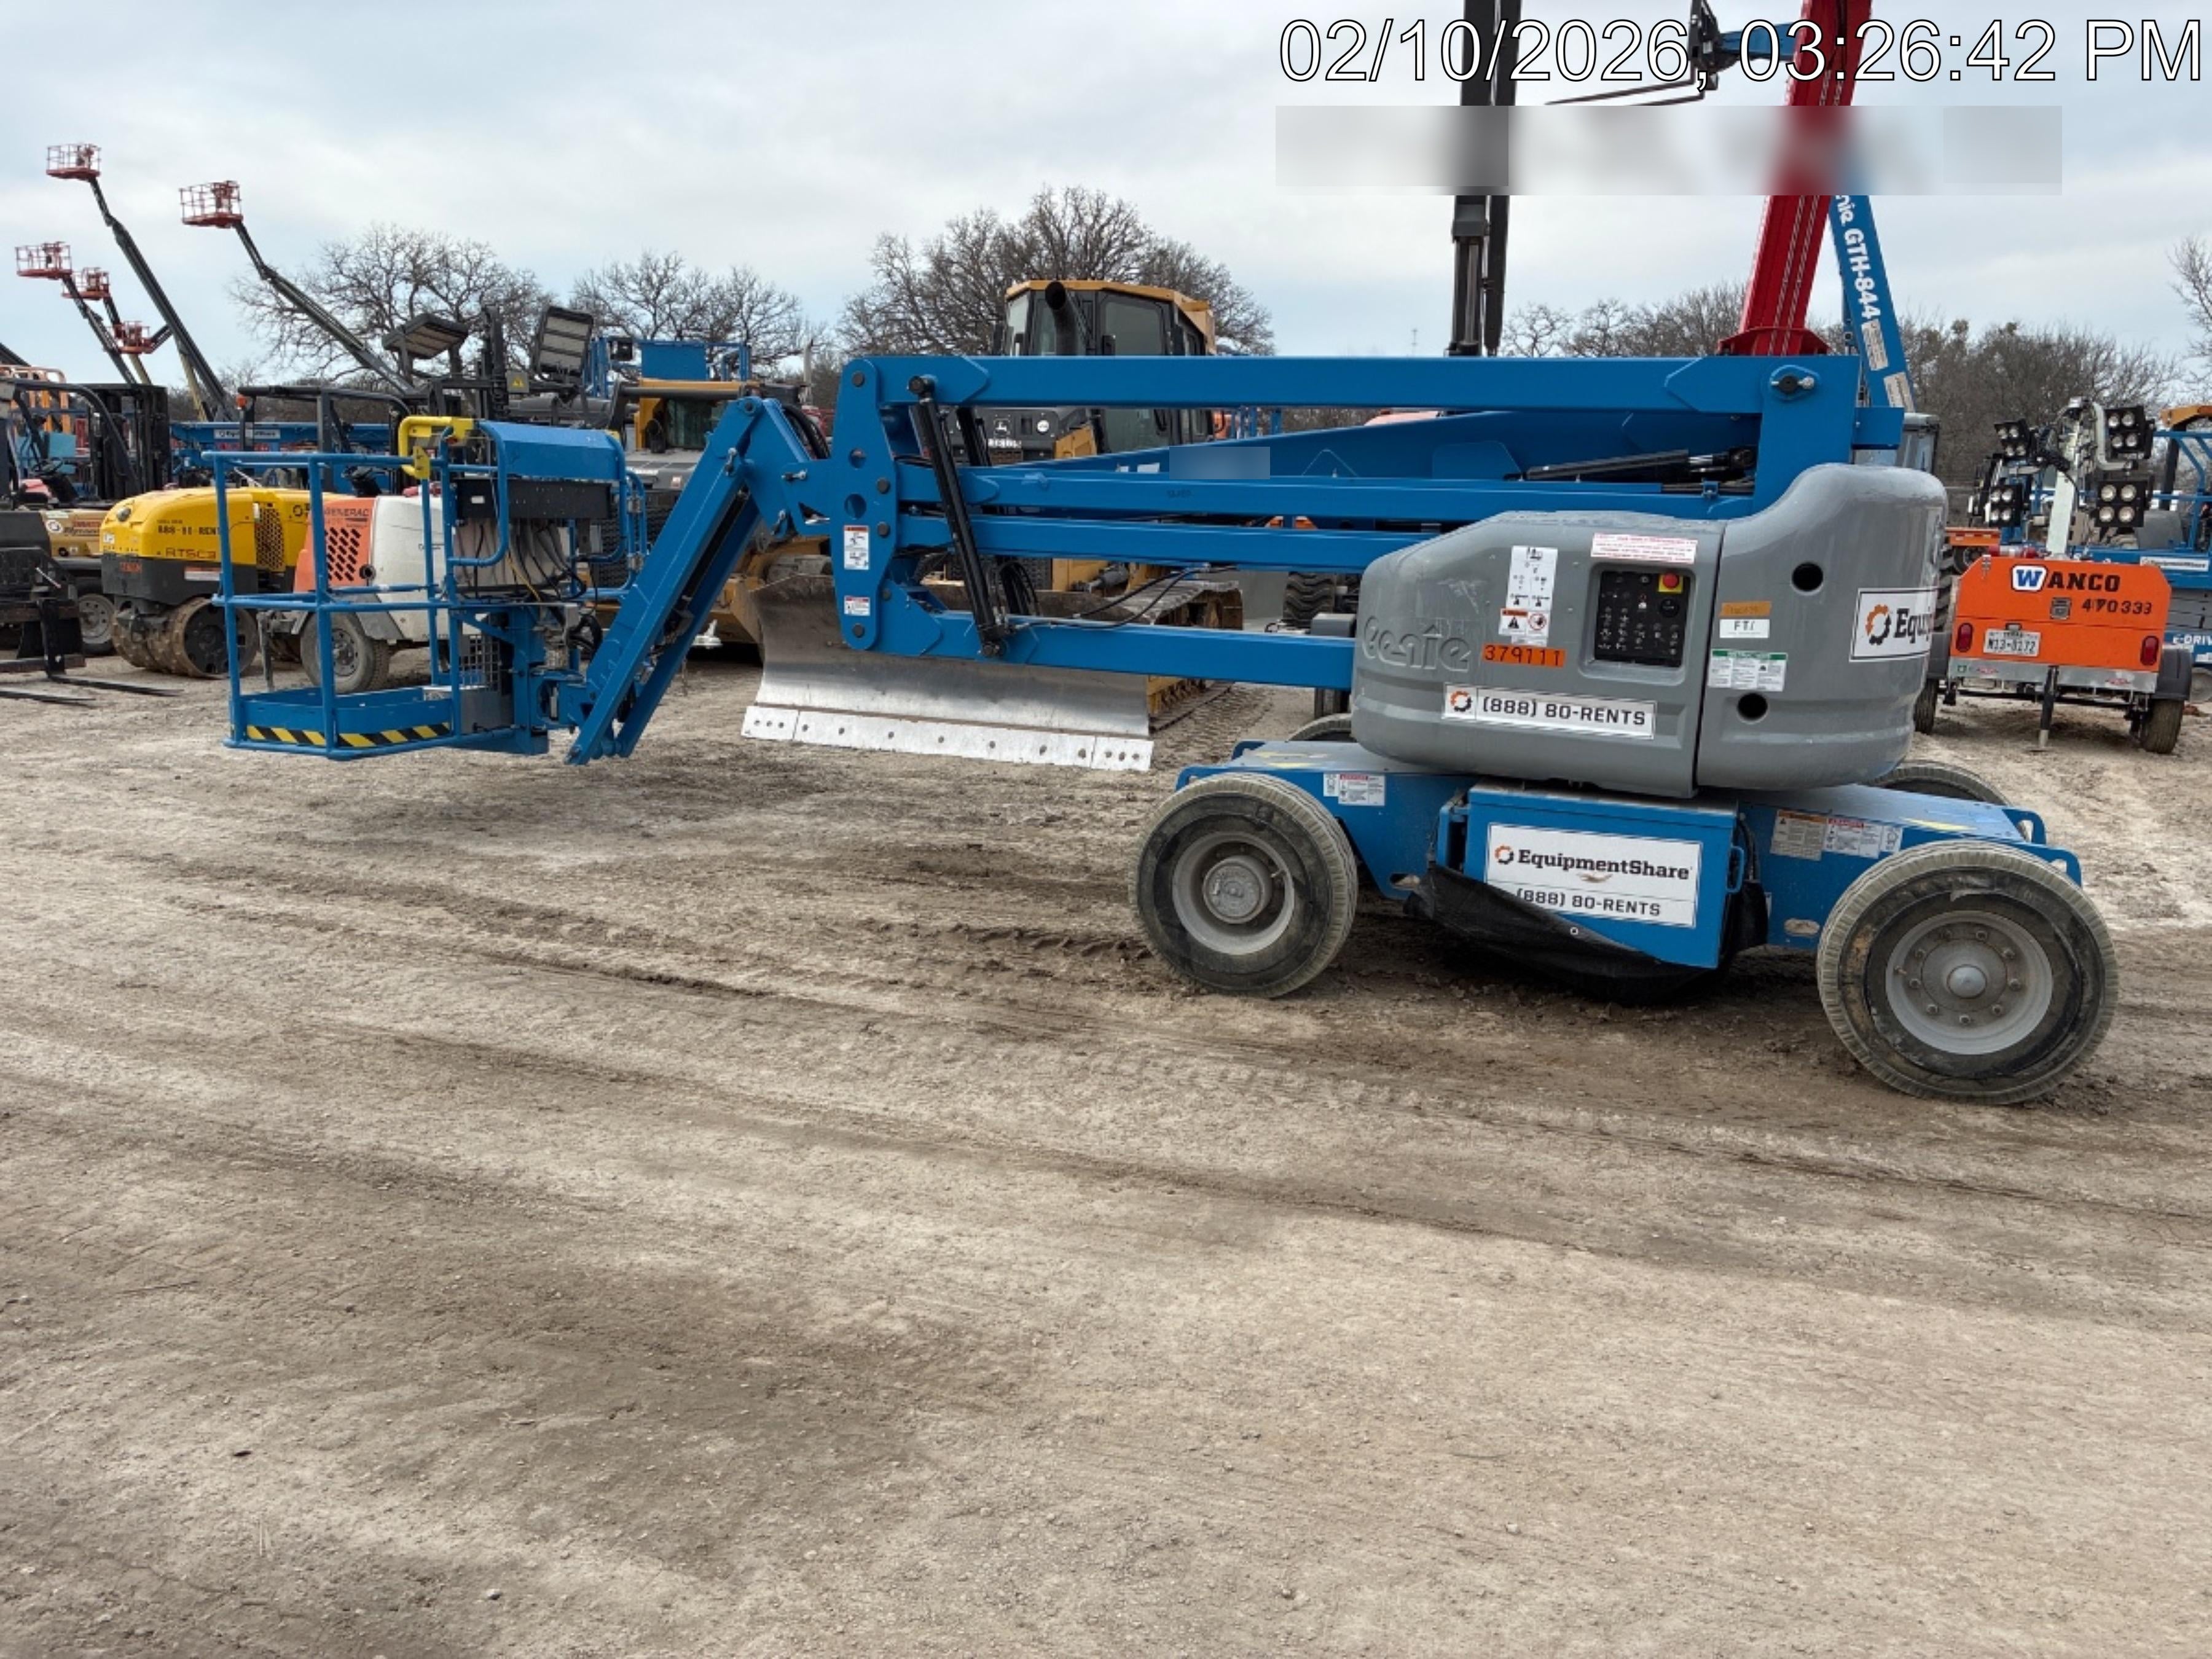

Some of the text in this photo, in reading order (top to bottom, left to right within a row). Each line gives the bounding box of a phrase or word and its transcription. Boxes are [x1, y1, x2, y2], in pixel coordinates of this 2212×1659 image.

[1844, 228, 1881, 320] GTH-844
[2015, 569, 2121, 592] WANCO
[1482, 699, 1645, 726] (888) 80-RENTS
[1518, 849, 1690, 880] EquipmentShare
[1516, 888, 1661, 916] (888) 80-RENTS
